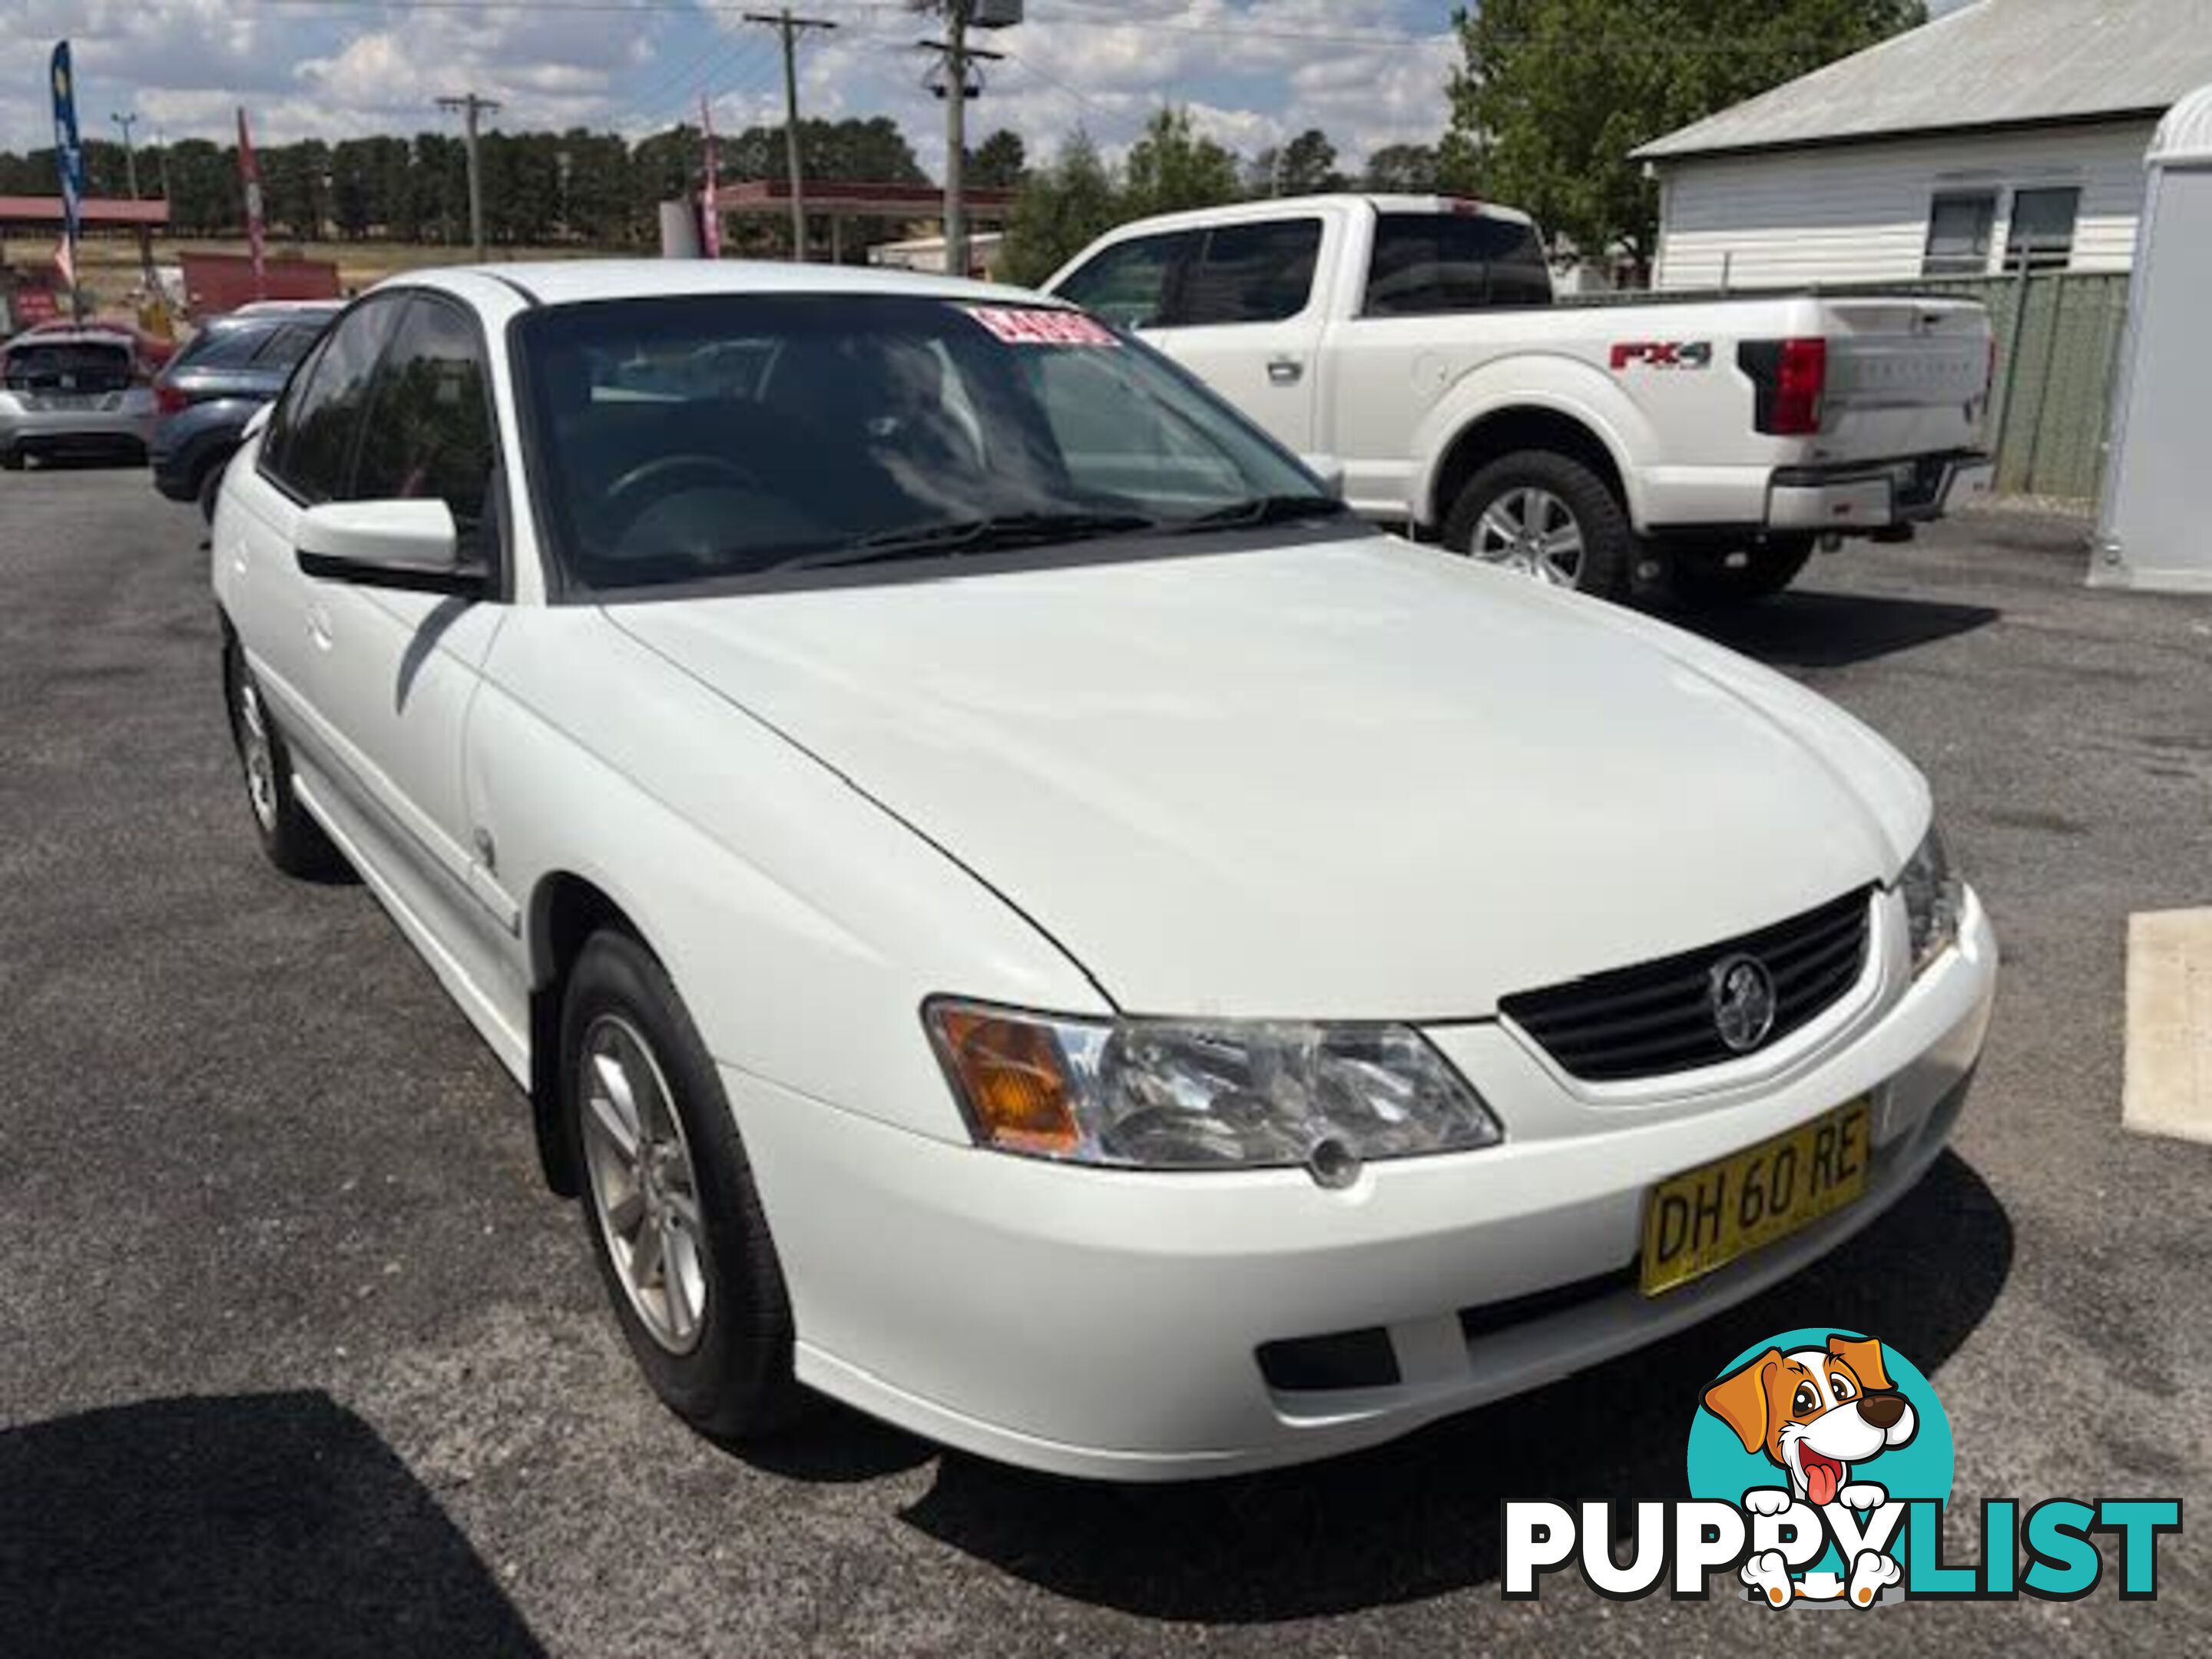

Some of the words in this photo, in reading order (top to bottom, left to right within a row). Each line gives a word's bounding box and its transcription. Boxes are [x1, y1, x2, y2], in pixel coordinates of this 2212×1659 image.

[1609, 341, 1712, 369] FX4
[1657, 1171, 1725, 1264] DH
[1738, 1144, 1796, 1228] 60
[1810, 1108, 1865, 1199] RE
